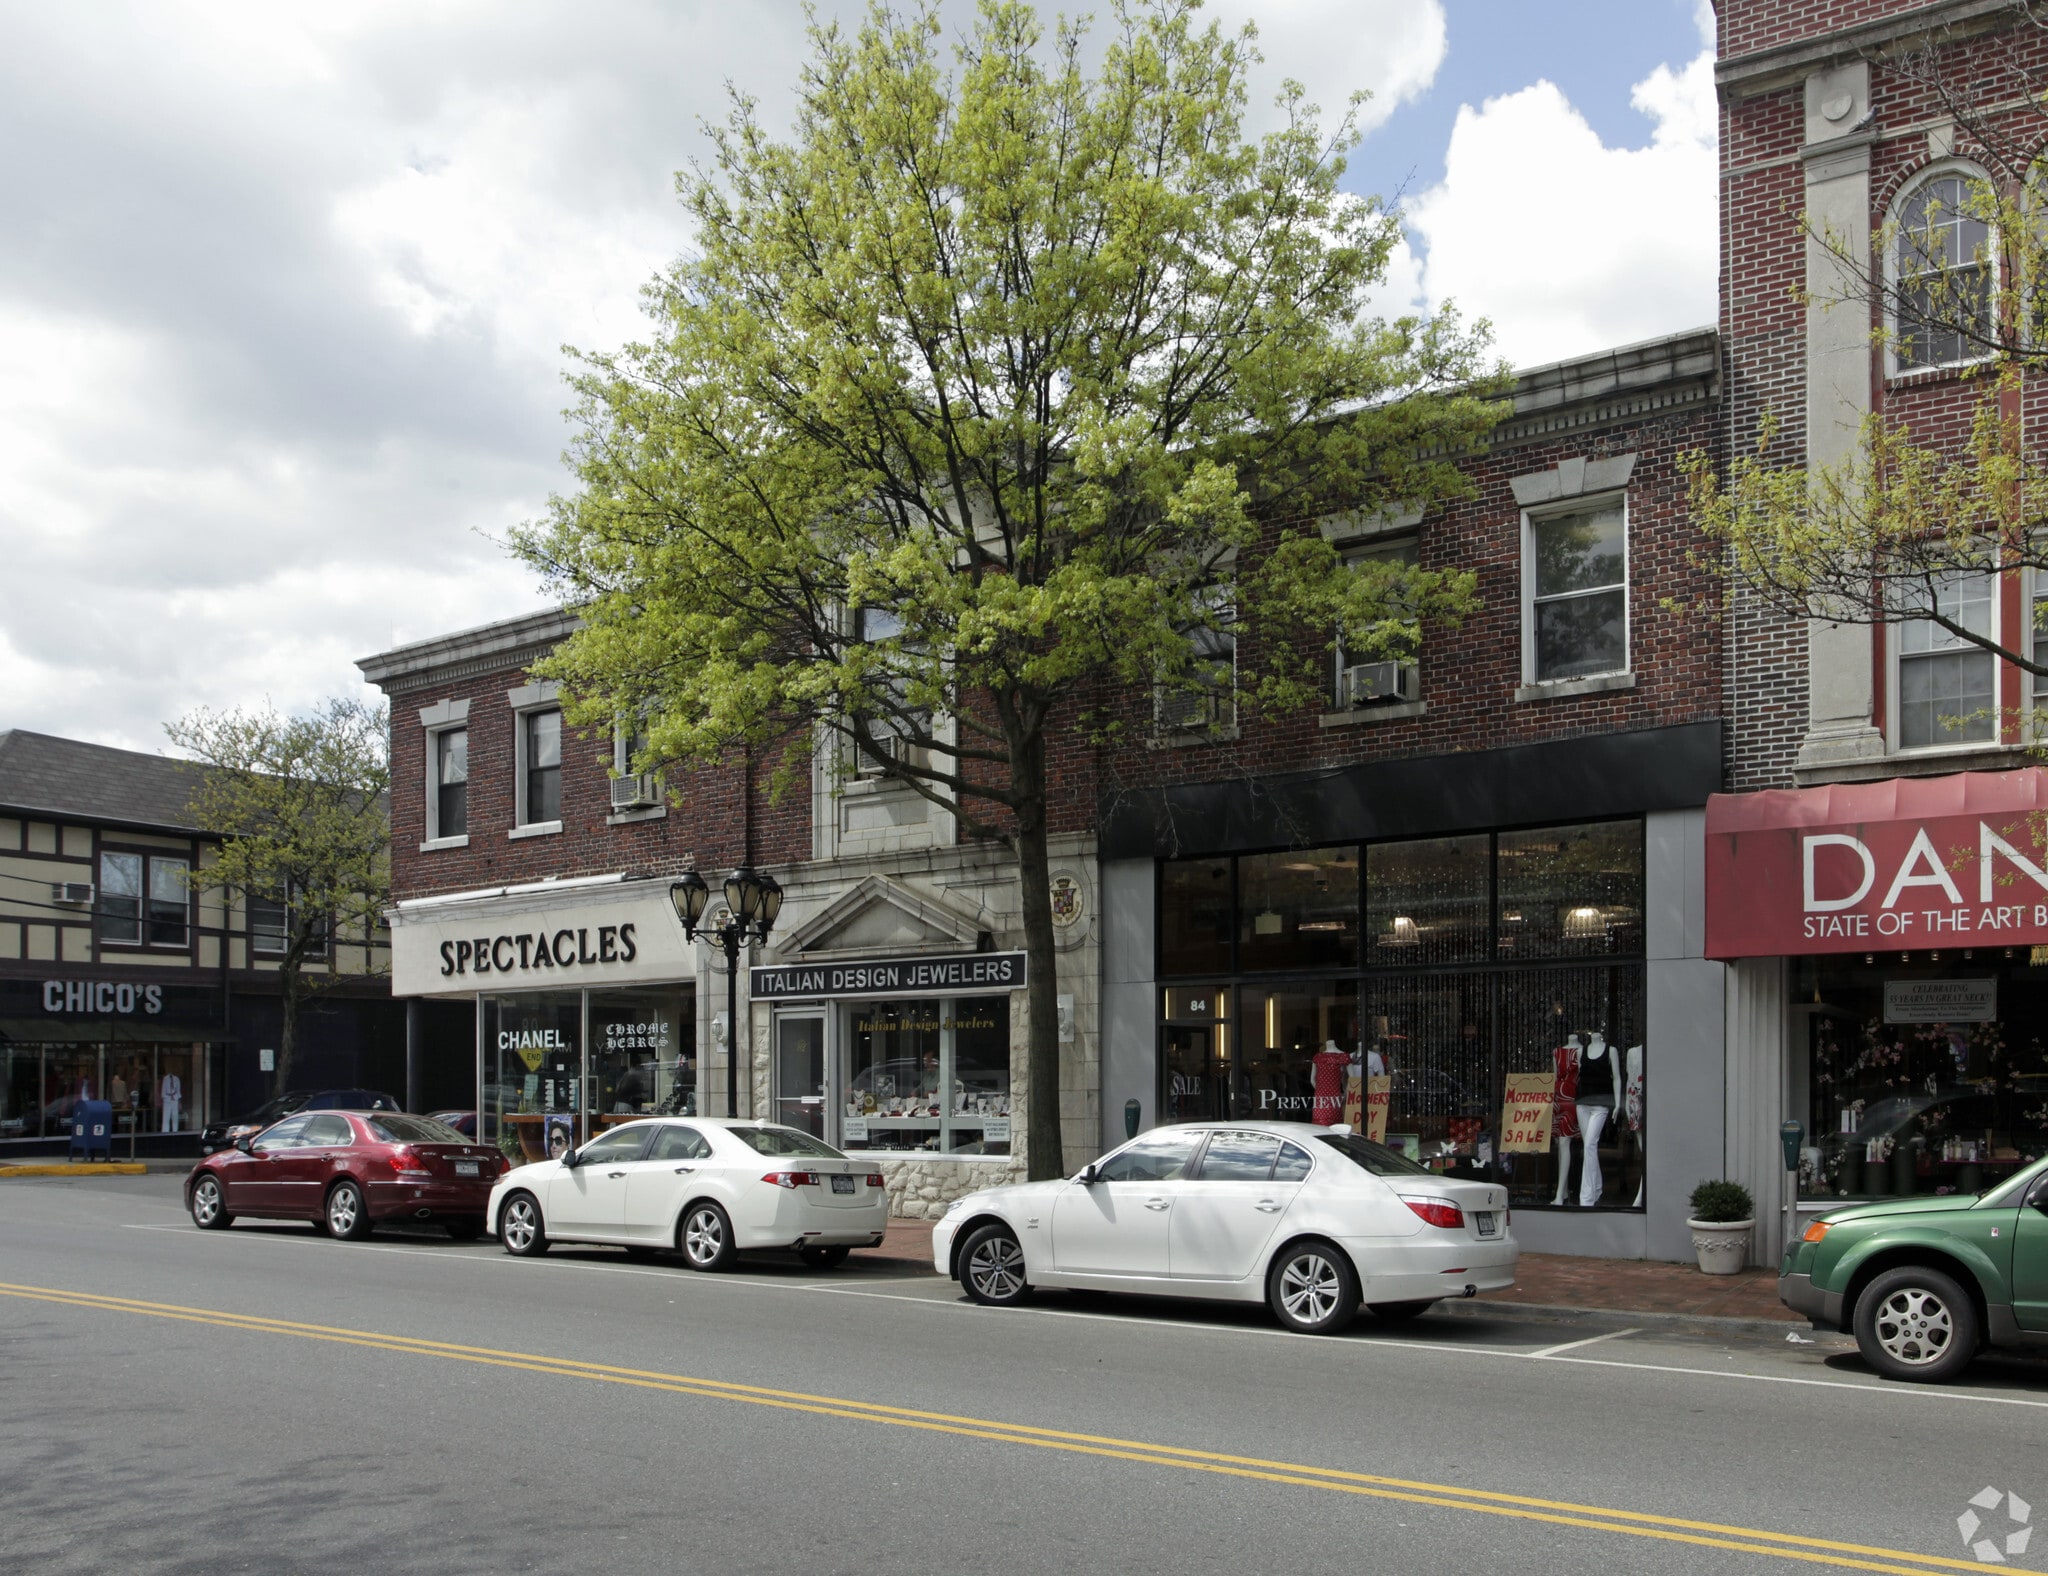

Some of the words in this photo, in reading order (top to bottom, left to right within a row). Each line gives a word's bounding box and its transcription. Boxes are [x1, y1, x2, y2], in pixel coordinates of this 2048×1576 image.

[1803, 820, 2048, 913] DAN
[1803, 914, 1869, 938] STATE
[1876, 911, 1914, 936] OF
[1921, 908, 1971, 932] THE
[1977, 904, 2026, 930] ART
[440, 922, 637, 977] SPECTACLES
[760, 971, 825, 993] ITALIAN
[832, 967, 899, 989] DESIGN
[907, 960, 1013, 986] JEWELERS
[43, 980, 162, 1014] CHICO'S
[1190, 1000, 1206, 1012] 84
[605, 1022, 669, 1036] CHROME
[858, 1019, 897, 1032] Italian
[901, 1017, 939, 1033] Design
[942, 1016, 996, 1030] Jewelers
[498, 1029, 566, 1050] CHANEL
[605, 1036, 670, 1050] HEARTS
[526, 1052, 542, 1062] END
[1172, 1075, 1201, 1096] SALE
[1505, 1088, 1554, 1104] MOTHERS
[1353, 1111, 1378, 1124] DY
[1513, 1109, 1541, 1123] DAY
[1504, 1129, 1545, 1143] SALE
